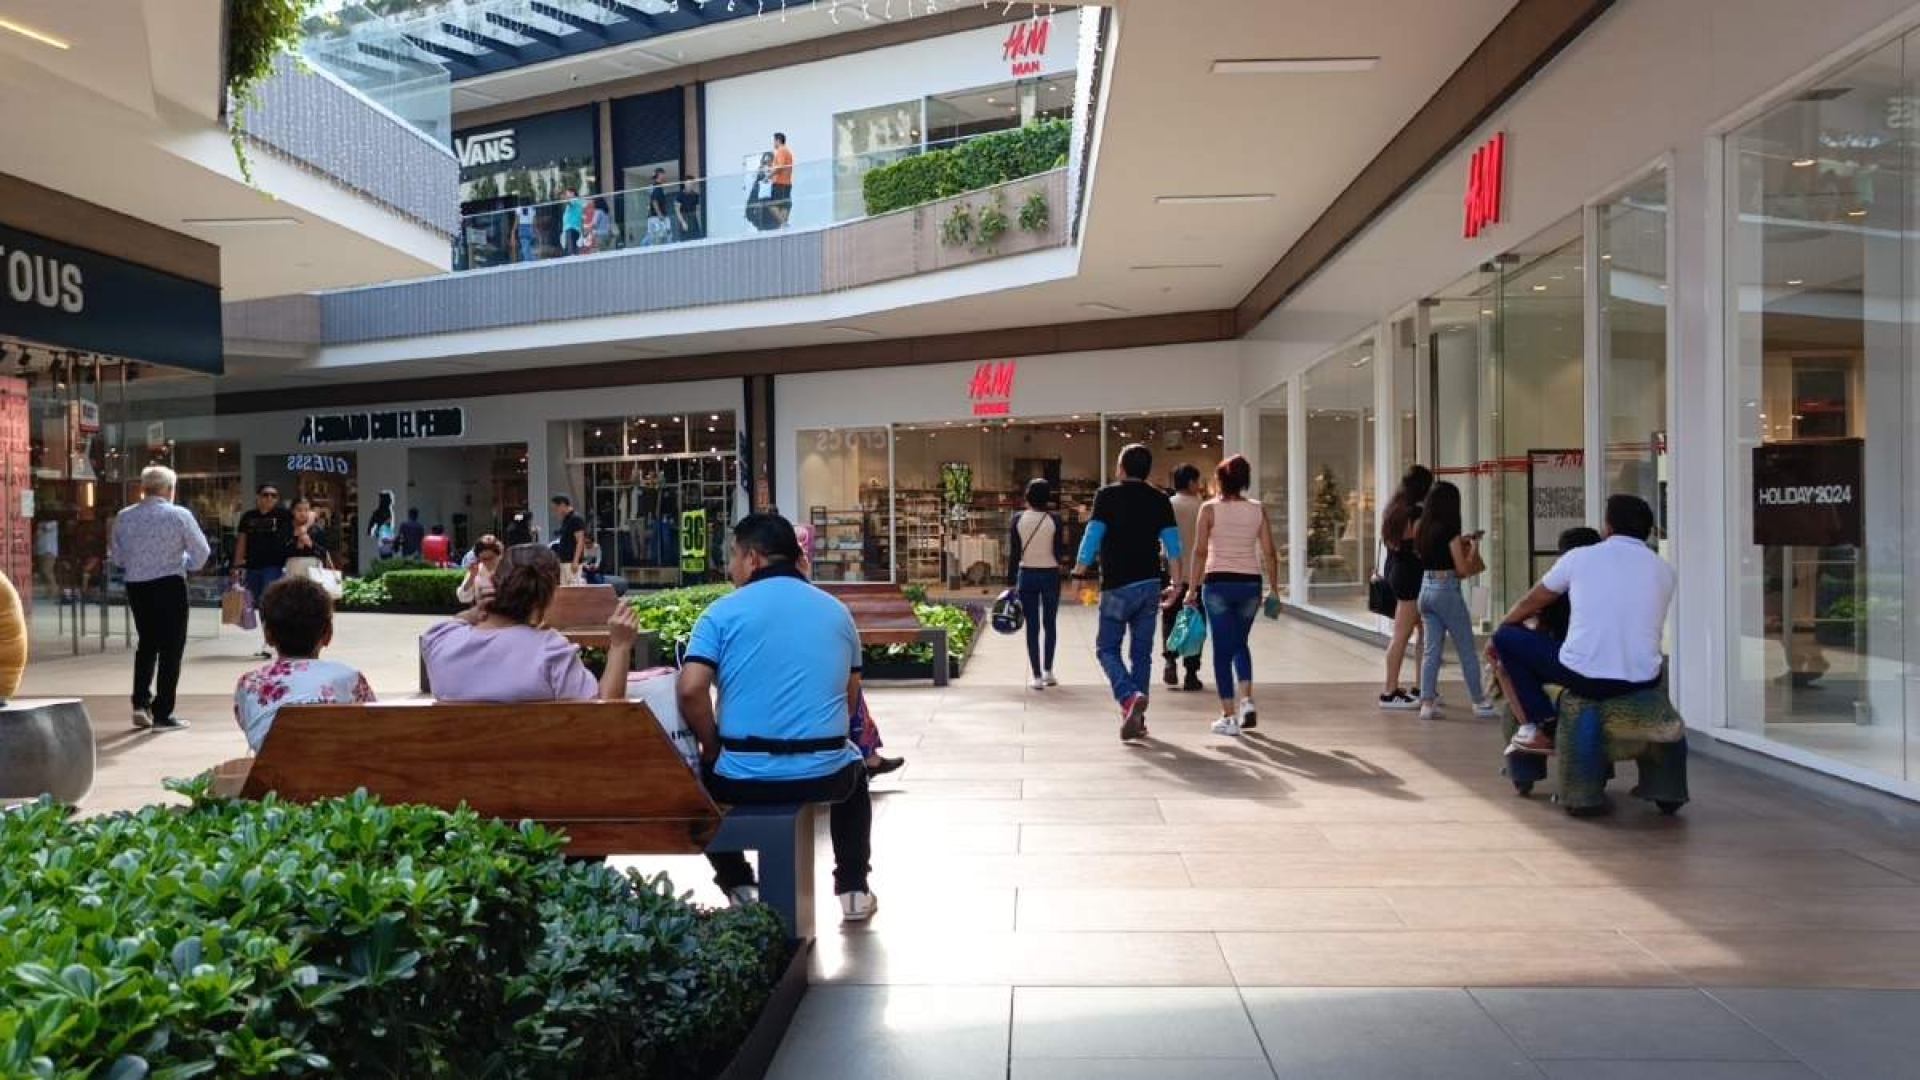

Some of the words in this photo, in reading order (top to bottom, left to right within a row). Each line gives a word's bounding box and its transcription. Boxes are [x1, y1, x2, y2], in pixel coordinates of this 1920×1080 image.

[1003, 19, 1049, 60] H&M
[1012, 60, 1040, 77] MAN
[454, 129, 516, 168] VANS
[0, 245, 84, 313] OUS
[969, 359, 1016, 399] H&M
[1759, 486, 1814, 505] HOLIDAY
[1815, 484, 1851, 503] 2024
